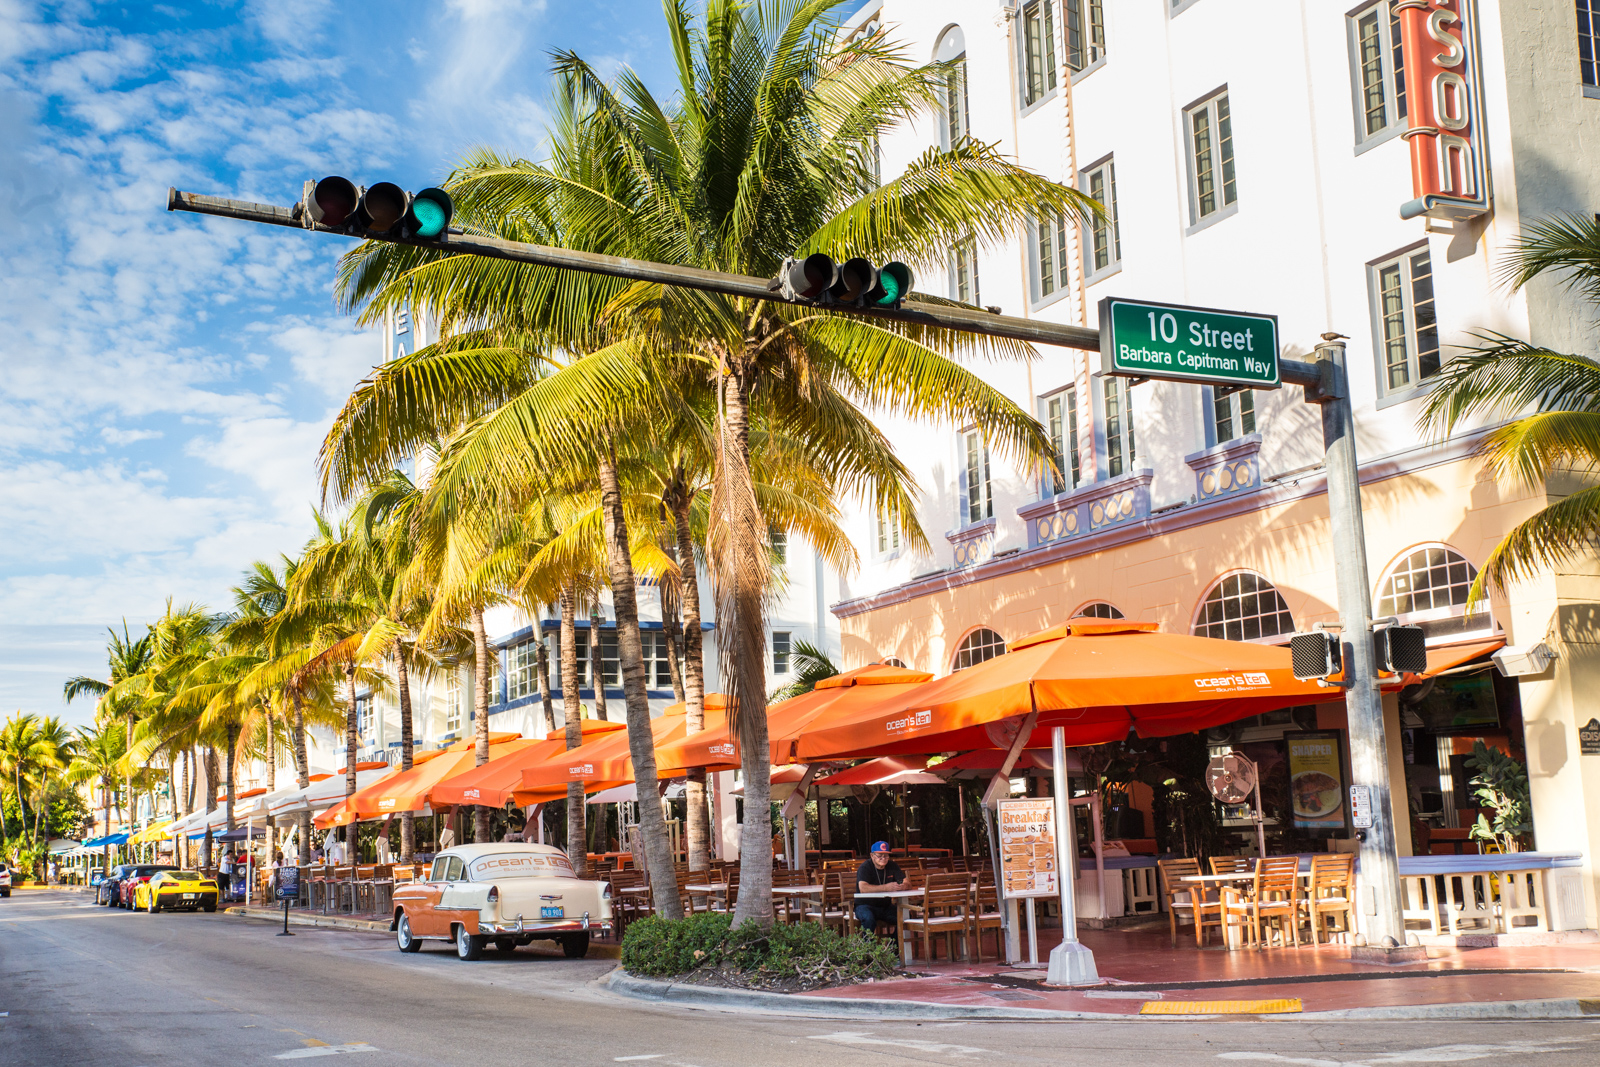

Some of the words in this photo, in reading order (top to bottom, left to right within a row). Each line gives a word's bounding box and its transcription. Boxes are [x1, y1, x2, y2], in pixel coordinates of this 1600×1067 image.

[1426, 7, 1476, 197] SON
[1147, 311, 1178, 344] 10
[1188, 321, 1254, 352] Street
[1119, 343, 1172, 365] Barbara
[1177, 350, 1239, 371] Capitman
[1243, 356, 1271, 378] Way
[1194, 674, 1245, 688] ocean's
[1244, 673, 1270, 685] ten
[886, 715, 915, 731] ocean's
[916, 711, 931, 726] ten
[1580, 731, 1600, 742] EDIS
[1291, 744, 1332, 757] SNAPPER
[1002, 810, 1051, 824] Breakfast
[1003, 824, 1027, 834] Special
[476, 856, 545, 872] ocean's
